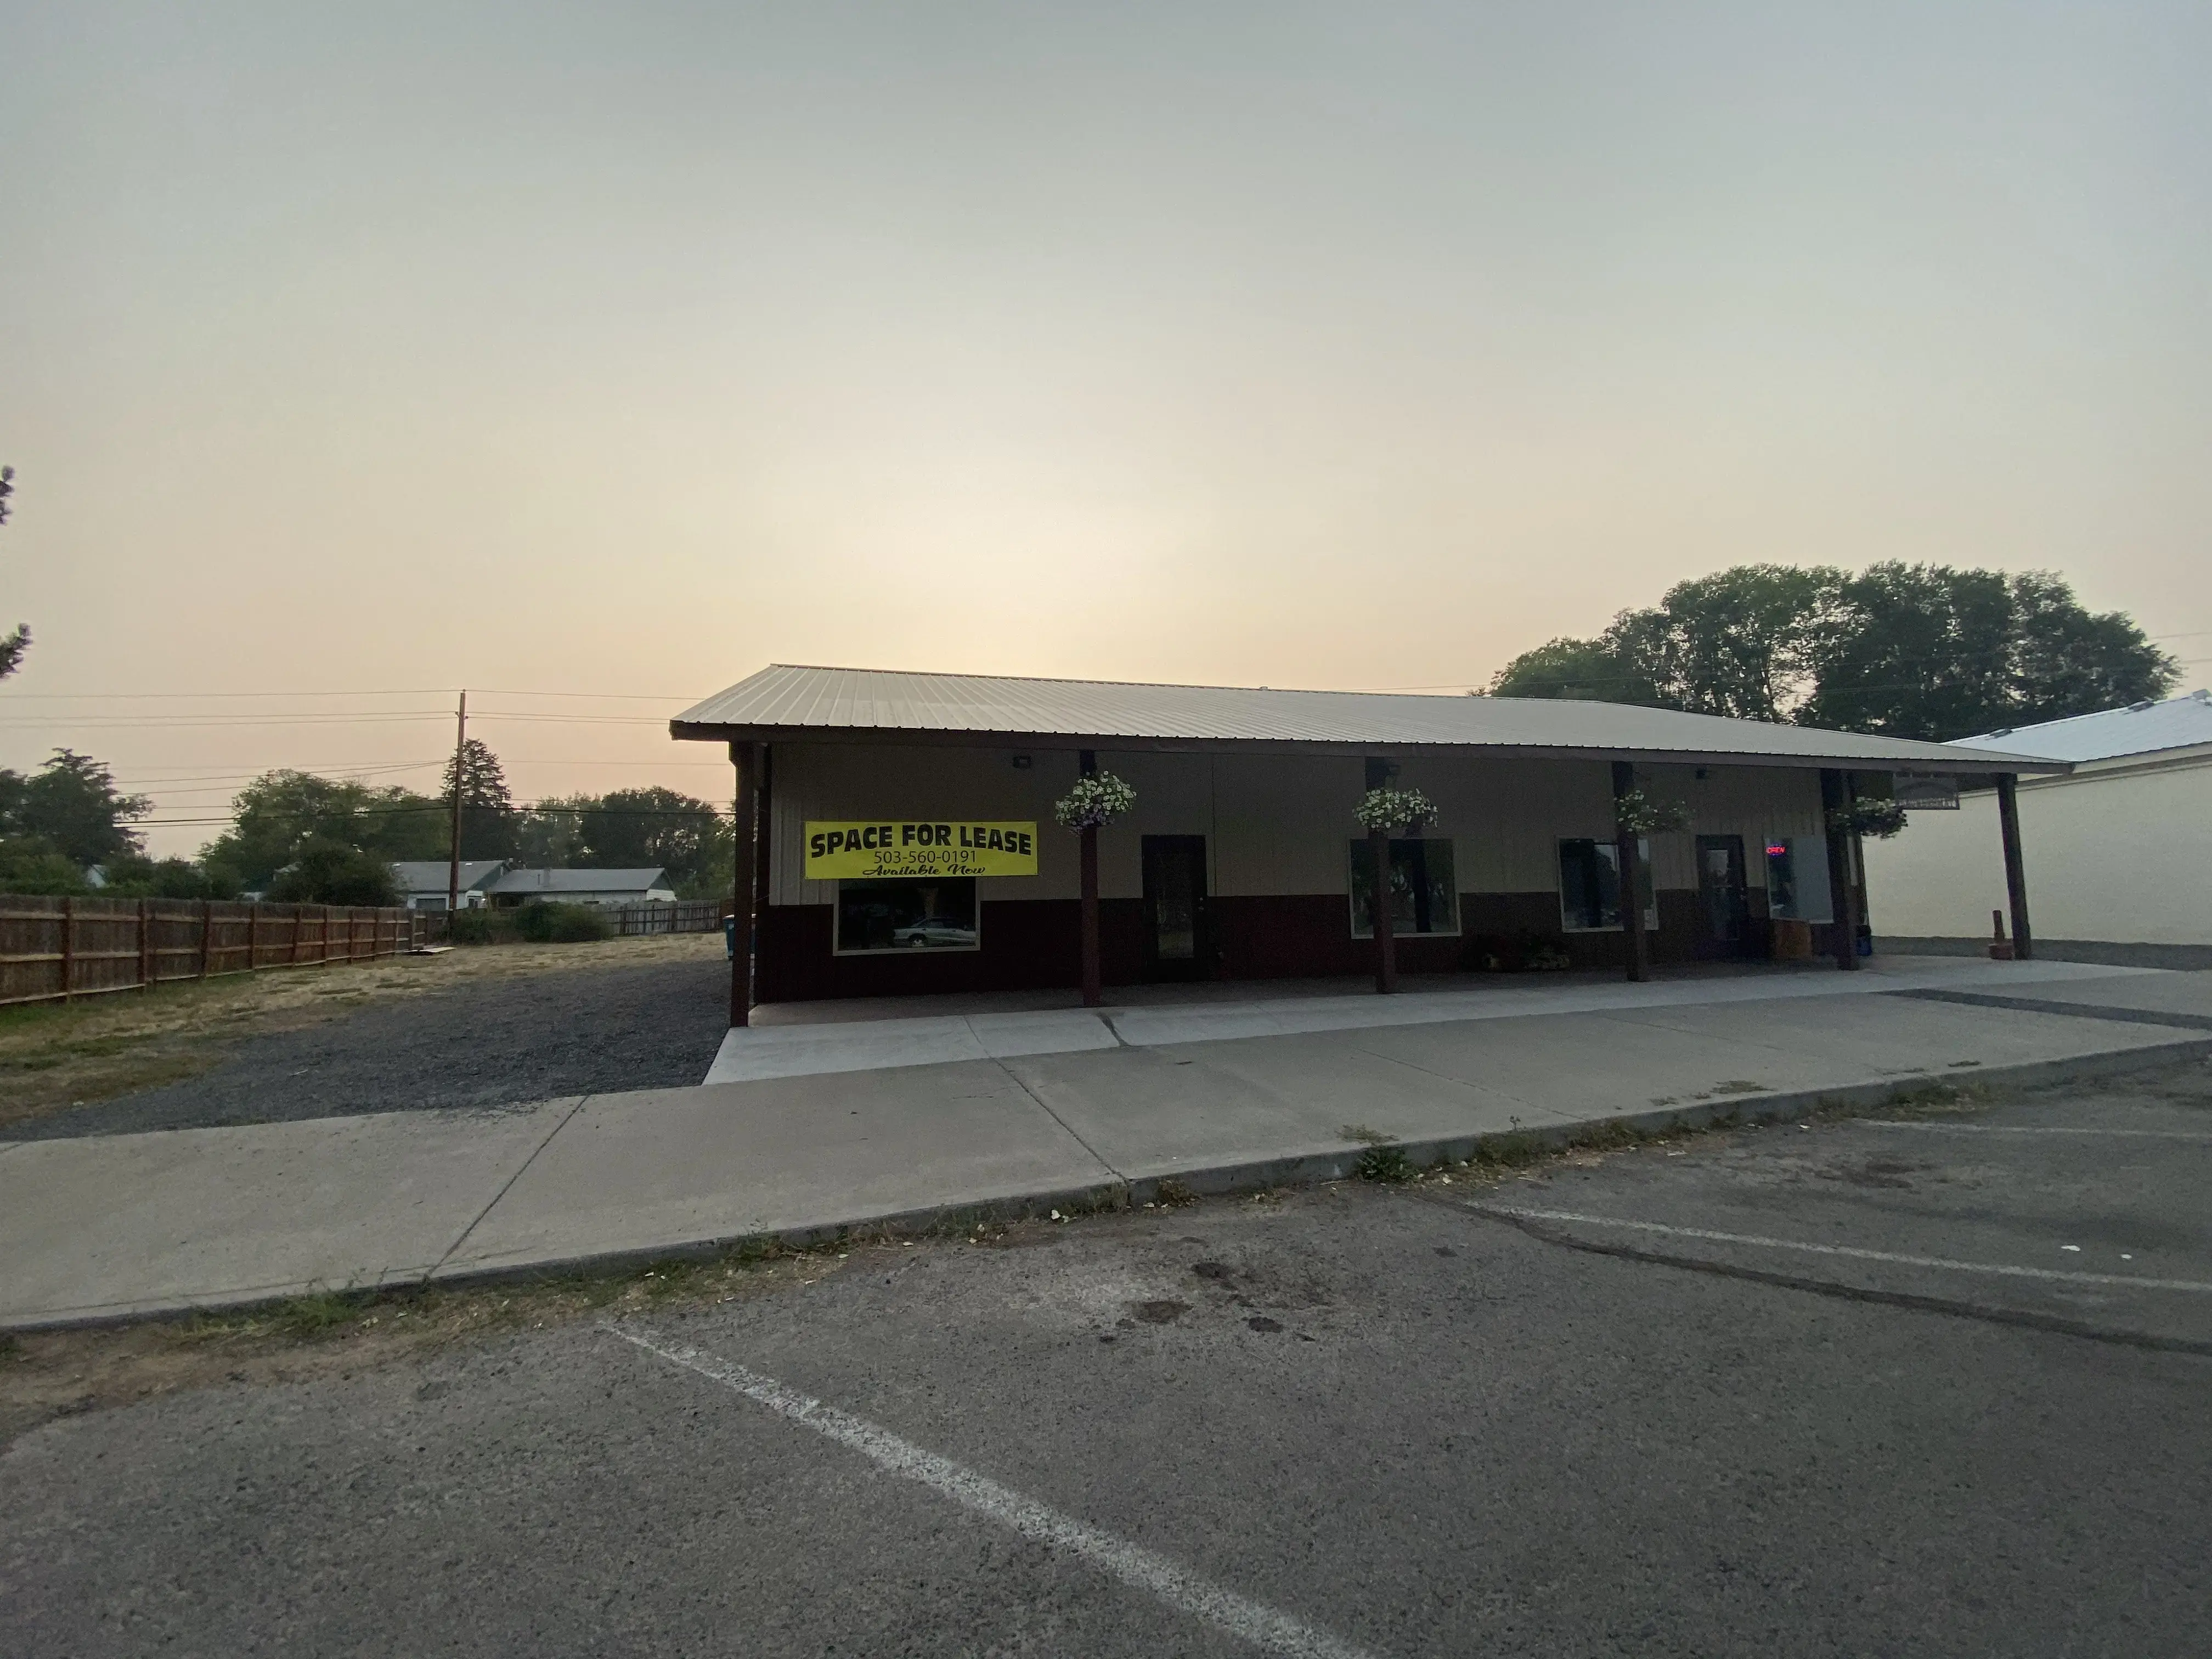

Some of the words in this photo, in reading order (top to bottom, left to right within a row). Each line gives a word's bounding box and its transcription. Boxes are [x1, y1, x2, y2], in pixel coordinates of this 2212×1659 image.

[810, 826, 893, 858] SPACE
[902, 825, 952, 846] FOR
[959, 826, 1031, 855] LEASE
[873, 850, 977, 864] 503-560-0191
[862, 865, 941, 877] Available
[947, 865, 986, 877] Now
